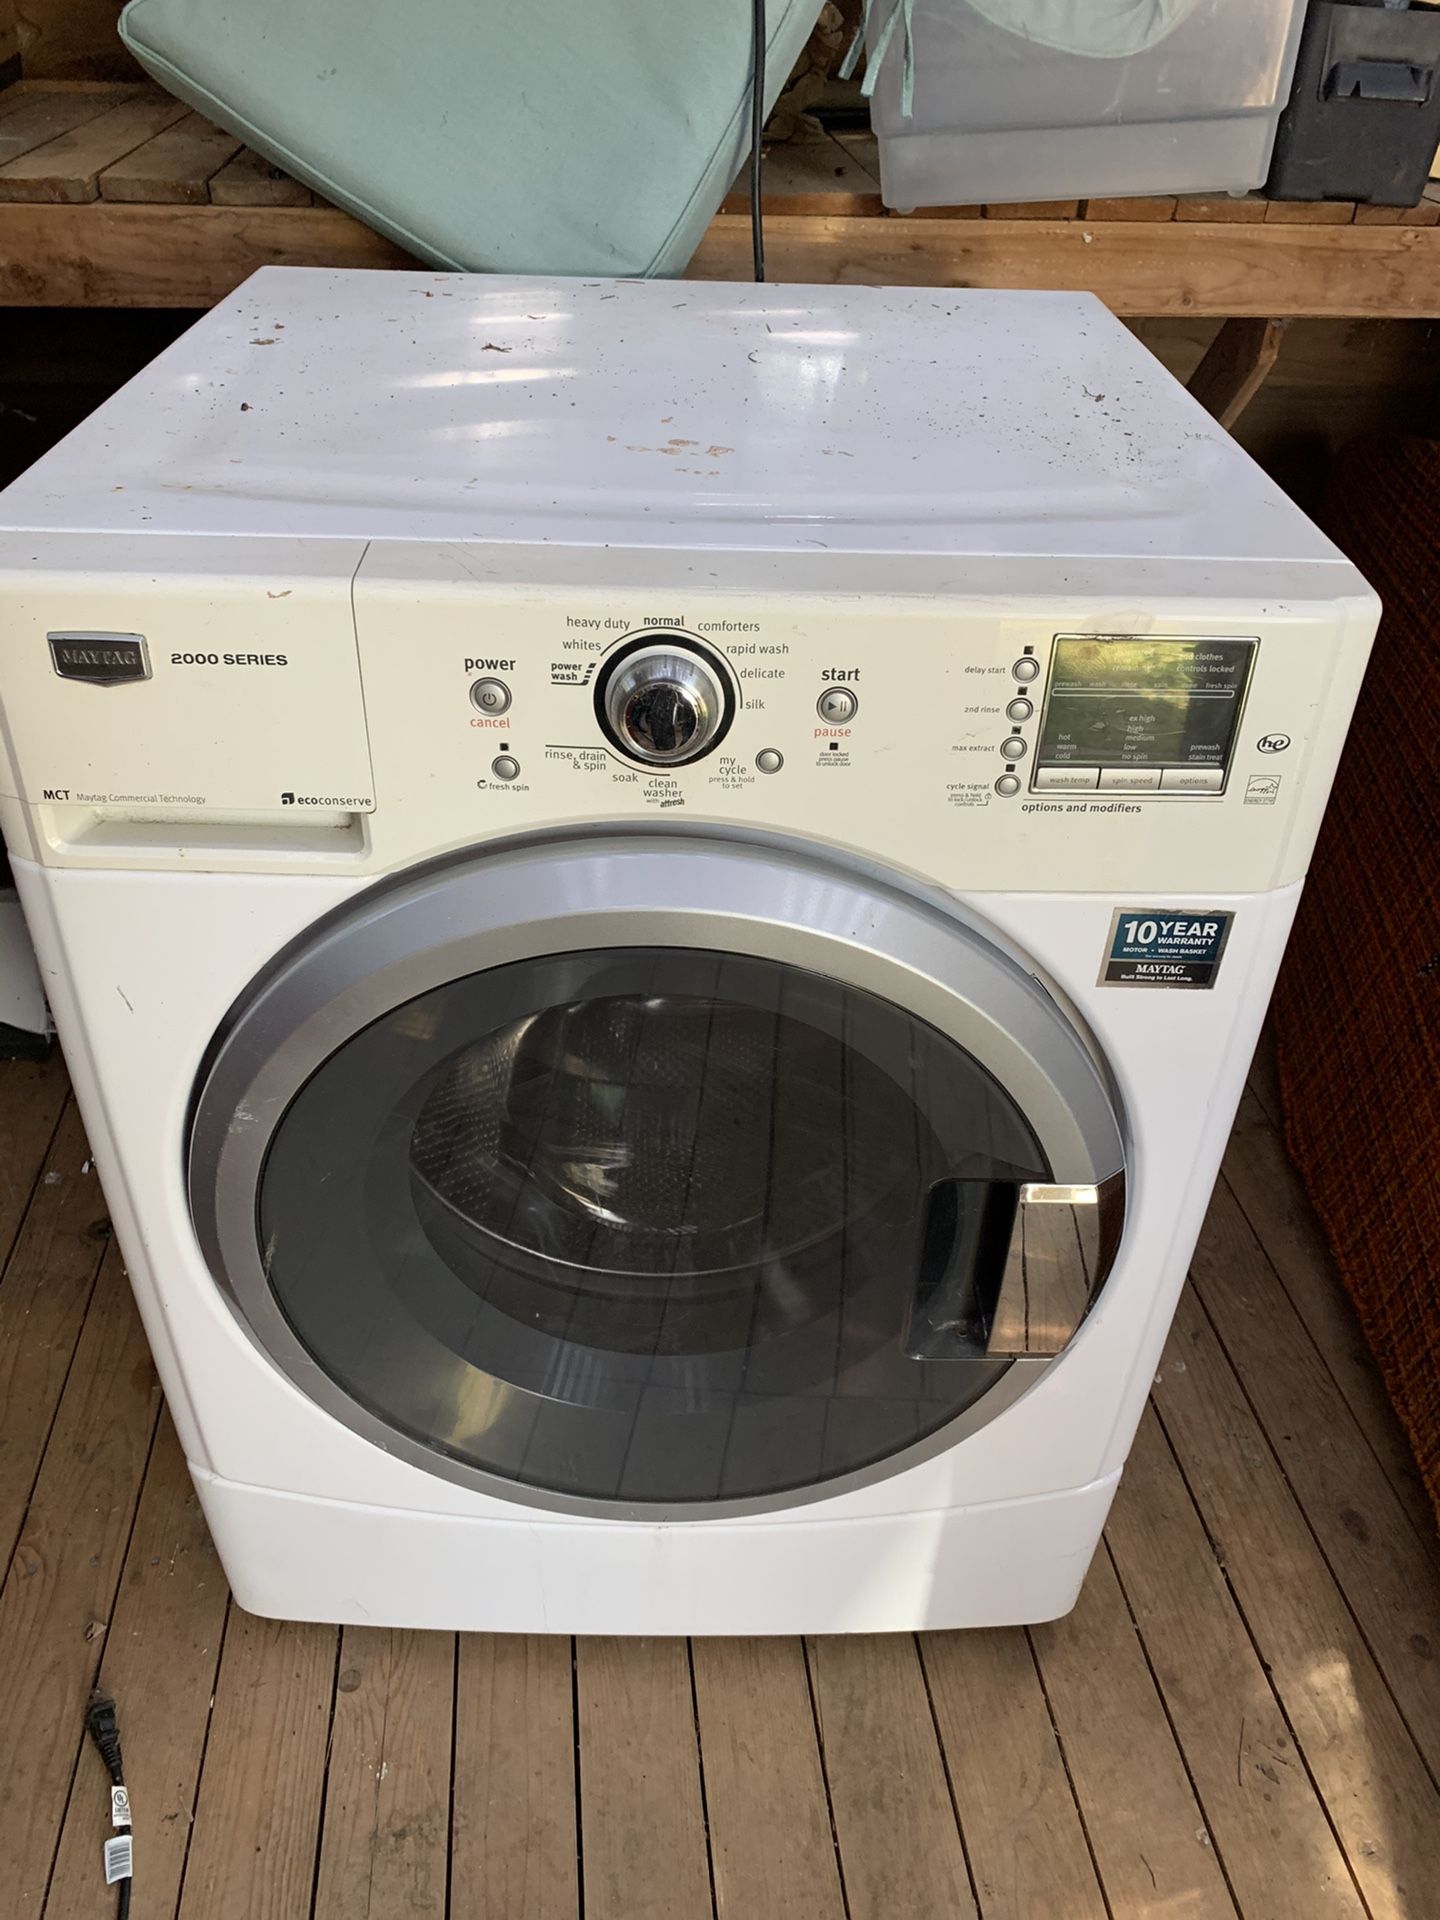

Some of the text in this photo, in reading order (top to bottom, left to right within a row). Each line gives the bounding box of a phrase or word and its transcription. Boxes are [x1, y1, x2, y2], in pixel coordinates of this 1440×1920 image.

[566, 616, 630, 631] heavy duty
[643, 616, 685, 626] normal
[697, 620, 760, 632] comforters
[562, 639, 601, 650] whites
[726, 643, 789, 656] rapid wash
[62, 649, 137, 665] MAYTAG
[171, 653, 288, 666] 2000 SERIES
[1195, 653, 1224, 661] clothes
[464, 657, 516, 672] power
[551, 662, 582, 673] power
[1176, 665, 1235, 673] controls locked
[740, 668, 785, 679] delicate
[821, 668, 860, 681] start
[964, 666, 986, 675] delay
[551, 672, 578, 681] wash
[745, 699, 766, 710] silk
[964, 705, 1001, 713] 2nd rinse
[1139, 713, 1156, 723] high
[470, 718, 511, 729] cancel
[814, 728, 852, 739] pause
[1058, 733, 1071, 741] hot
[968, 744, 995, 752] extract
[1123, 743, 1138, 751] low
[1190, 743, 1221, 752] prewash
[545, 749, 607, 761] rinse, drain
[1055, 752, 1072, 760] cold
[1188, 753, 1206, 761] stain
[572, 760, 607, 772] & spin
[719, 757, 737, 766] my
[719, 765, 747, 776] cycle
[612, 773, 639, 782] soak
[708, 776, 730, 784] press
[489, 782, 530, 792] fresh spin
[648, 778, 678, 788] clean
[967, 783, 990, 791] signal
[43, 790, 70, 800] MCT
[643, 788, 683, 798] washer
[77, 793, 206, 805] Maytag Commercial Technology
[297, 797, 372, 806] ecoconserve
[660, 798, 685, 808] affresh
[1021, 803, 1142, 815] options and modifiers
[1125, 921, 1218, 944] 10 YEAR
[1157, 937, 1215, 946] WARRANTY
[1136, 964, 1186, 974] MAYTAG
